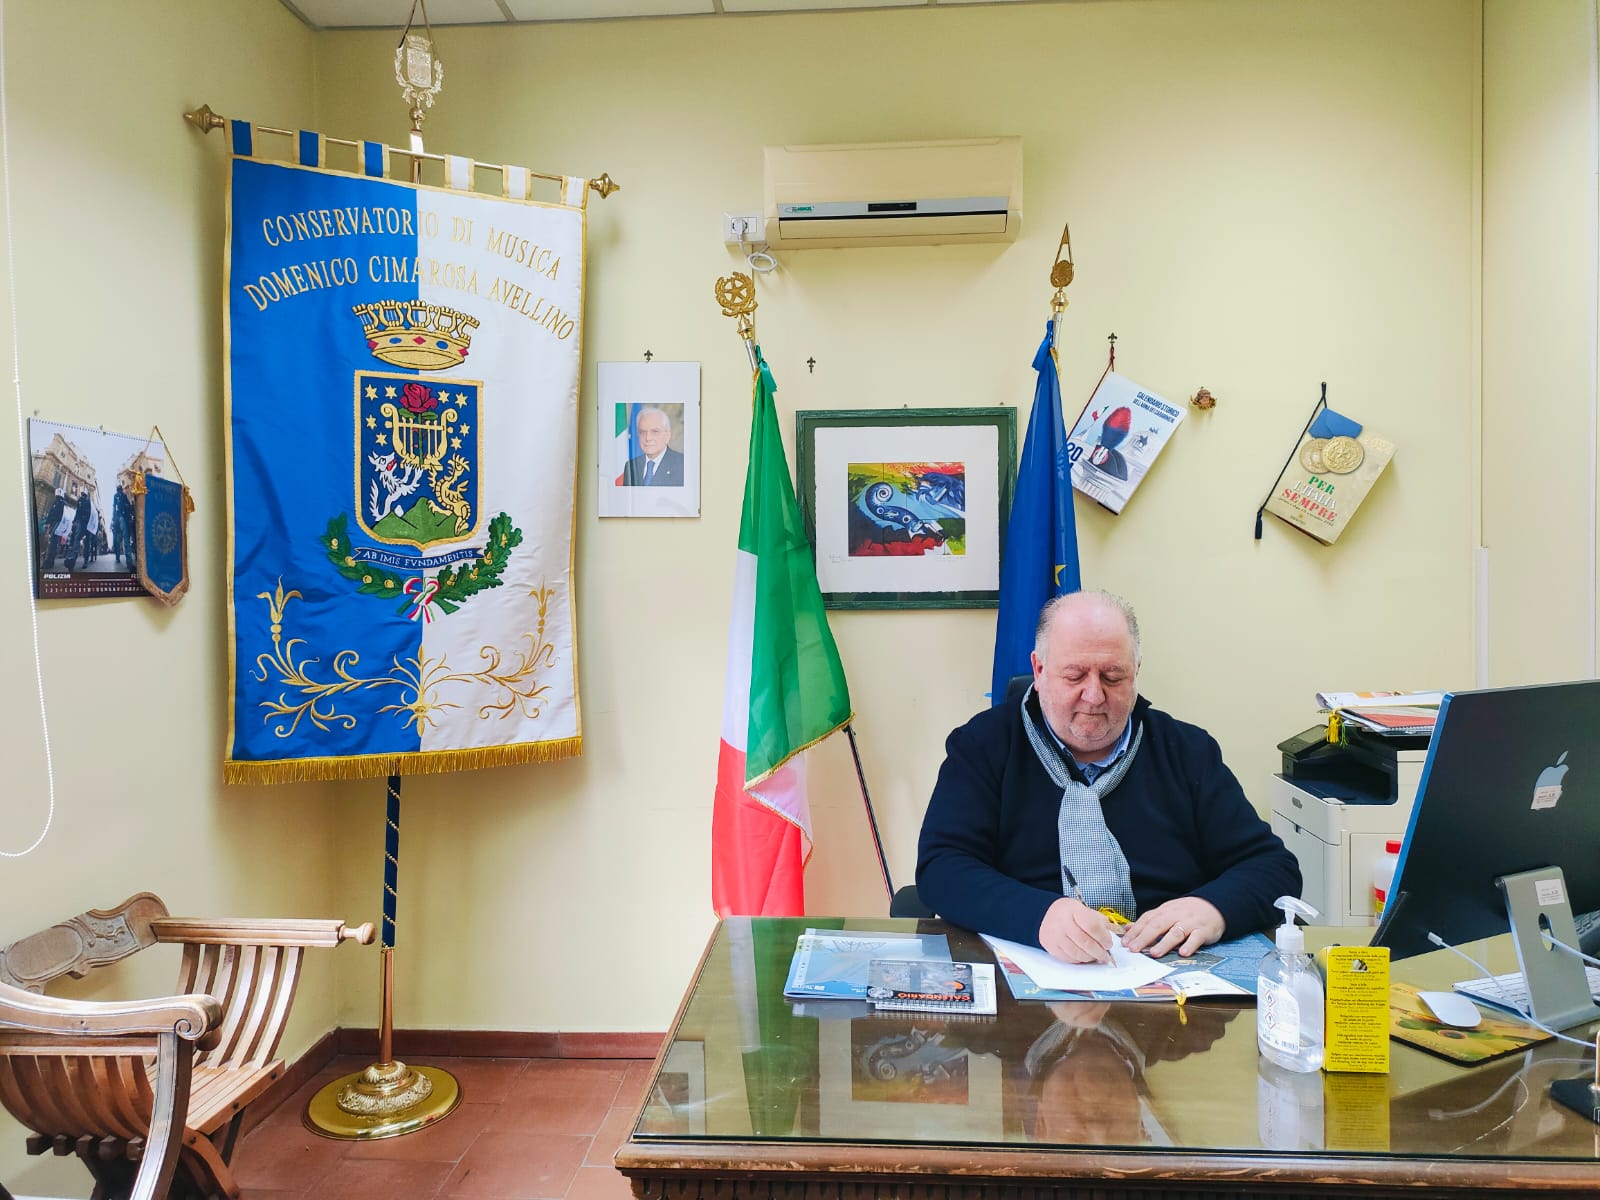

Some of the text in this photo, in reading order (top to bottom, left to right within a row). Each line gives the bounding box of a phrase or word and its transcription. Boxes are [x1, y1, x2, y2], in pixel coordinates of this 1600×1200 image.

[262, 207, 562, 281] CONSERVATORIO DI MUSICA
[243, 255, 575, 341] DOMENICO CIMAROSA AVELLINO
[1308, 475, 1335, 495] PER
[1282, 488, 1338, 522] SEMPRE
[363, 549, 473, 567] AB IMIS FVNDAMENTIS
[897, 992, 971, 1002] CALENDARIO
